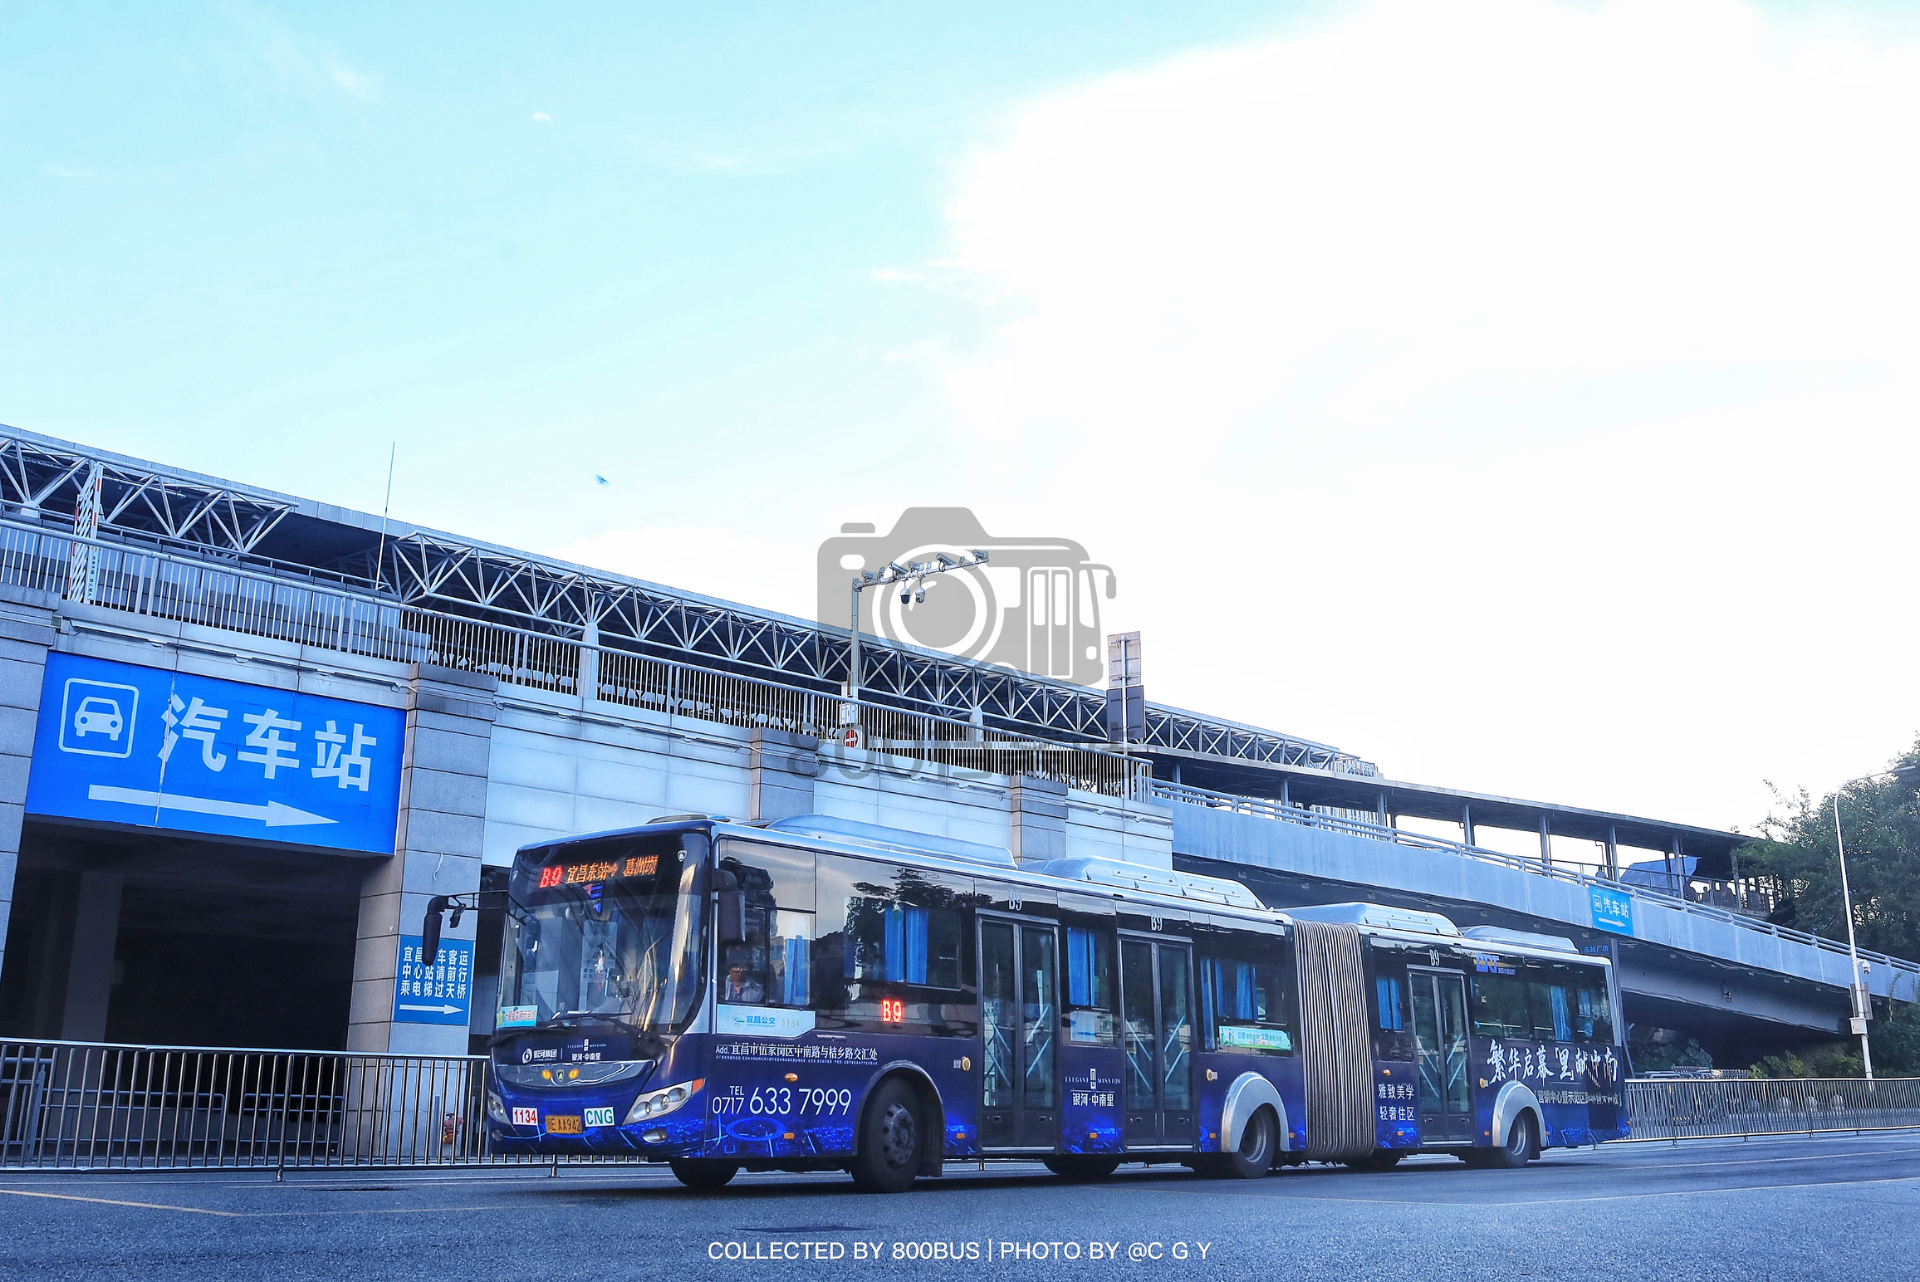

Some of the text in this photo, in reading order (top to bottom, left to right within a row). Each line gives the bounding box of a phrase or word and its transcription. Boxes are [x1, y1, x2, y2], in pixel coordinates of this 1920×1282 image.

[157, 693, 378, 792] 汽车站
[540, 866, 564, 888] B9
[565, 861, 609, 884] 宜昌东站
[1008, 888, 1022, 911] B9
[1603, 897, 1629, 918] 汽车站
[1151, 914, 1163, 931] B9
[403, 946, 469, 966] 宜昌车客运
[1429, 949, 1440, 966] B9
[402, 962, 468, 983] 中心站请前行
[400, 980, 466, 999] 乘电梯过天桥
[882, 1000, 902, 1022] B9
[746, 1015, 776, 1025] 宜昌公交
[782, 1019, 800, 1028] 1134
[729, 1085, 744, 1096] TEL
[1378, 1083, 1414, 1100] 雅致美学
[712, 1087, 851, 1116] 0717 633 7999
[1073, 1092, 1115, 1107] 银河·中南里
[514, 1109, 537, 1123] 1134
[586, 1109, 613, 1125] CNG
[1380, 1106, 1415, 1121] 轻奢住区
